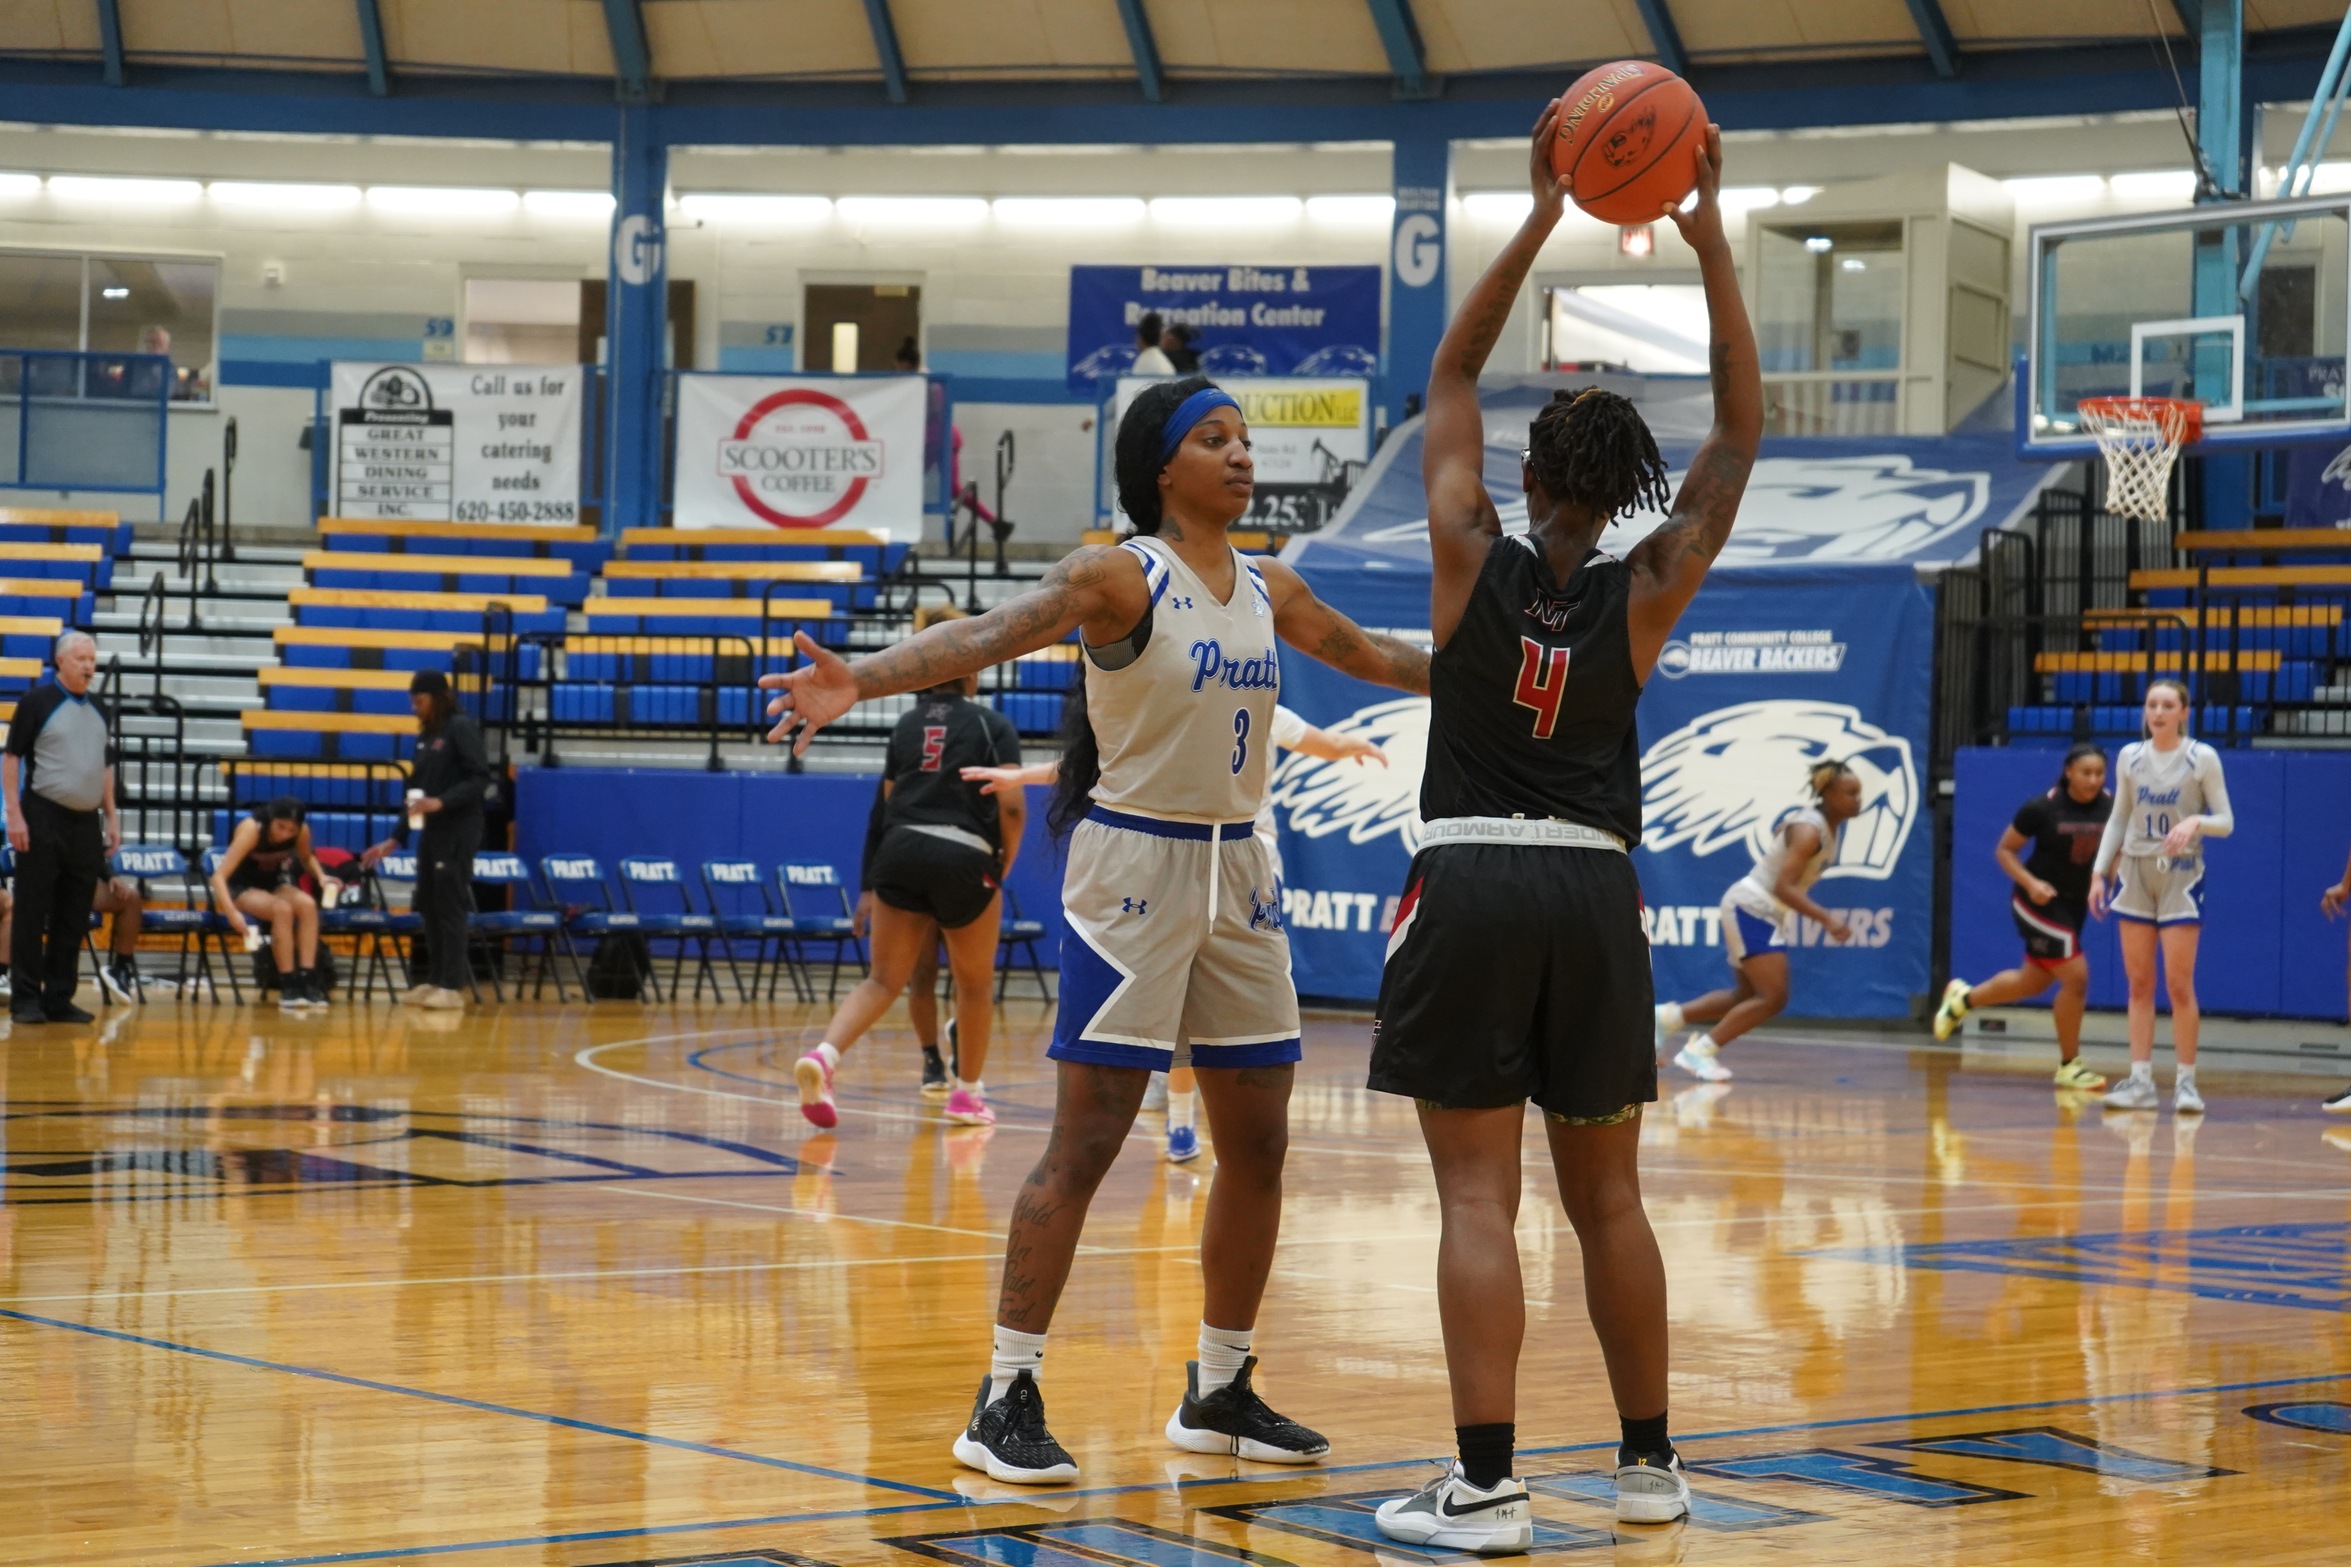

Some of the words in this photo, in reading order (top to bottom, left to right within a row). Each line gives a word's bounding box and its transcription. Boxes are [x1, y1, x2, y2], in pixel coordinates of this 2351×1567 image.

[1559, 64, 1645, 145] SPALDING
[616, 213, 661, 285] G
[1395, 213, 1440, 287] G
[1141, 267, 1222, 291] Beaver
[1227, 267, 1285, 292] Bites
[1291, 268, 1310, 291] &
[1125, 301, 1246, 326] Rereation
[1251, 303, 1326, 327] Center
[471, 375, 506, 395] Call
[514, 381, 532, 395] us
[540, 375, 565, 395] for
[1242, 393, 1337, 422] UCTION
[498, 413, 537, 431] your
[367, 429, 425, 441] GREAT
[354, 447, 439, 460] WESTERN
[481, 439, 553, 463] catering
[725, 446, 877, 471] SCOOTER'S
[364, 466, 428, 480] DINING
[492, 470, 541, 491] needs
[762, 475, 835, 493] COFFEE
[358, 485, 433, 498] SERVICE
[456, 501, 574, 522] 620-450-2888
[1689, 647, 1755, 671] BEAVER
[1759, 645, 1839, 670] BACKERS
[1512, 635, 1571, 740] 4
[919, 725, 947, 772] 5
[1230, 706, 1251, 777] 3
[1424, 822, 1525, 842] ARMOUR
[2144, 812, 2171, 839] 10
[121, 850, 175, 871] PRATT
[551, 858, 596, 879] PRATT
[629, 861, 675, 881] PRATT
[711, 862, 756, 882] PRATT
[786, 865, 832, 884] PRATT
[1644, 905, 1722, 947] RATT
[1784, 906, 1894, 948] AVERS
